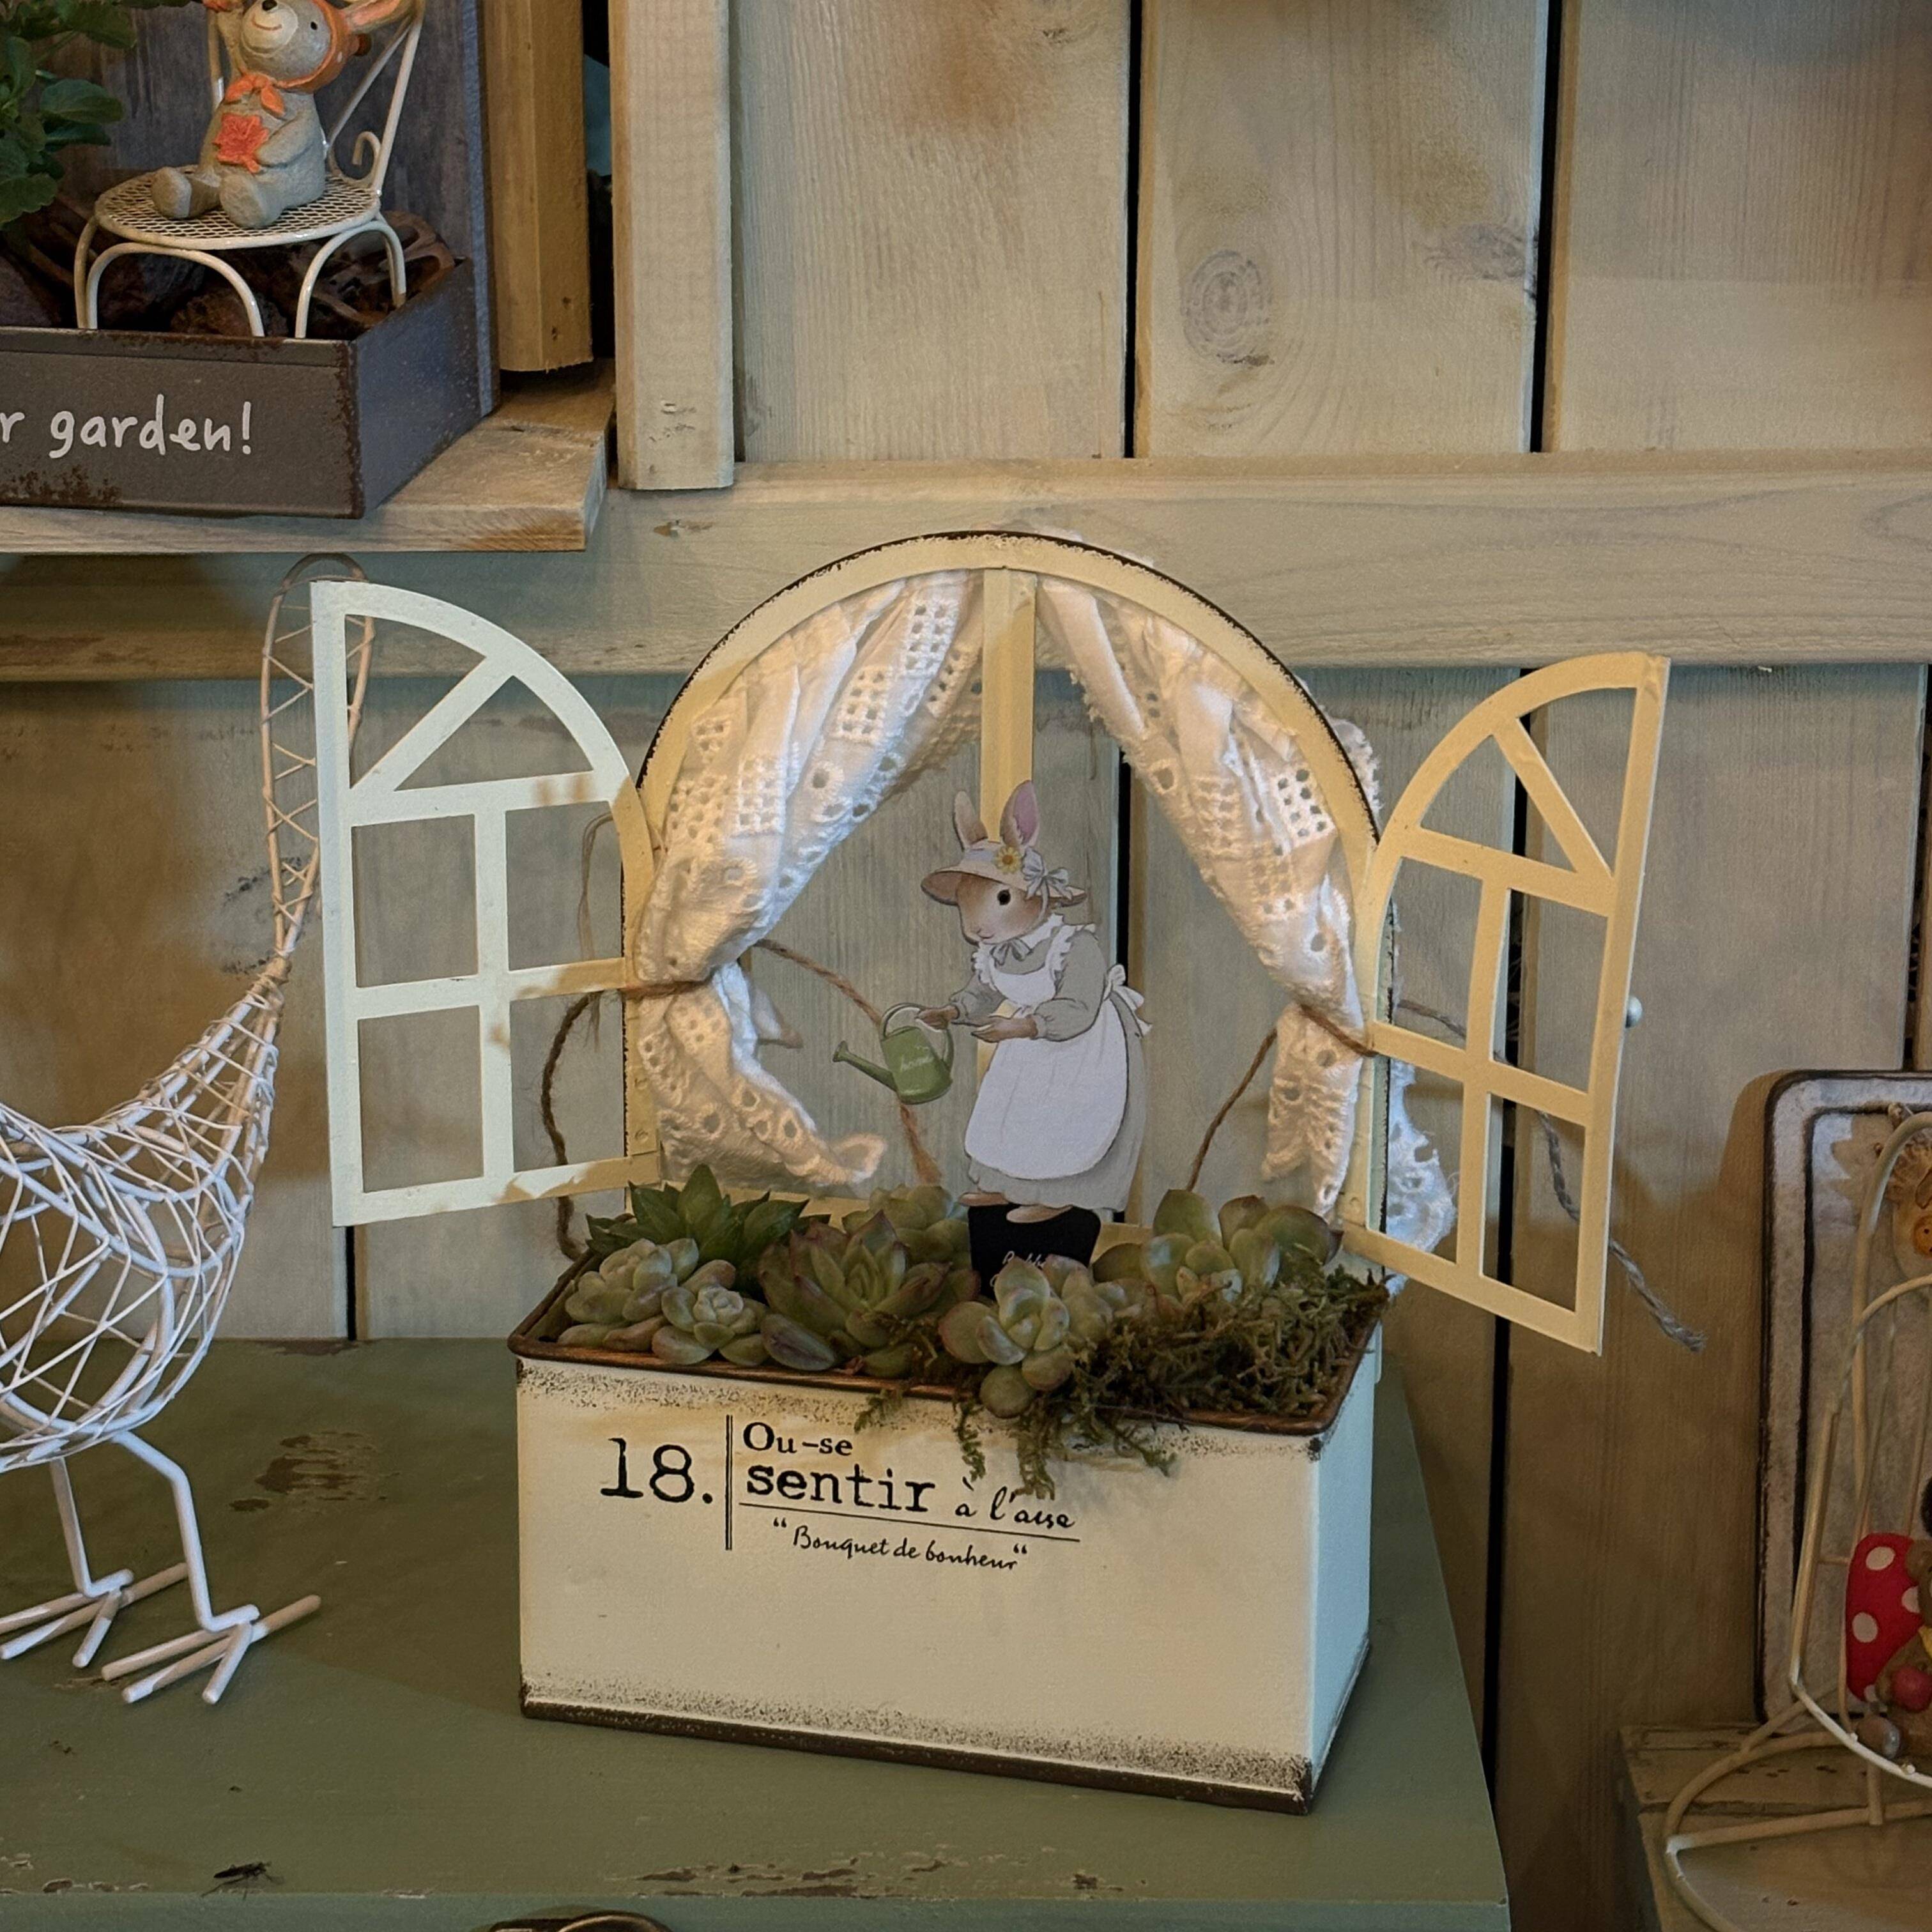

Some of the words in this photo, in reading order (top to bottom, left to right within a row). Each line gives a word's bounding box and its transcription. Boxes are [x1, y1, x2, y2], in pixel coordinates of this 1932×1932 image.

[49, 393, 252, 459] garden!
[742, 1421, 854, 1457] Ou-se
[599, 1437, 714, 1505] 18.
[746, 1463, 936, 1513] sentir
[954, 1476, 977, 1518] à
[893, 1537, 921, 1559] de
